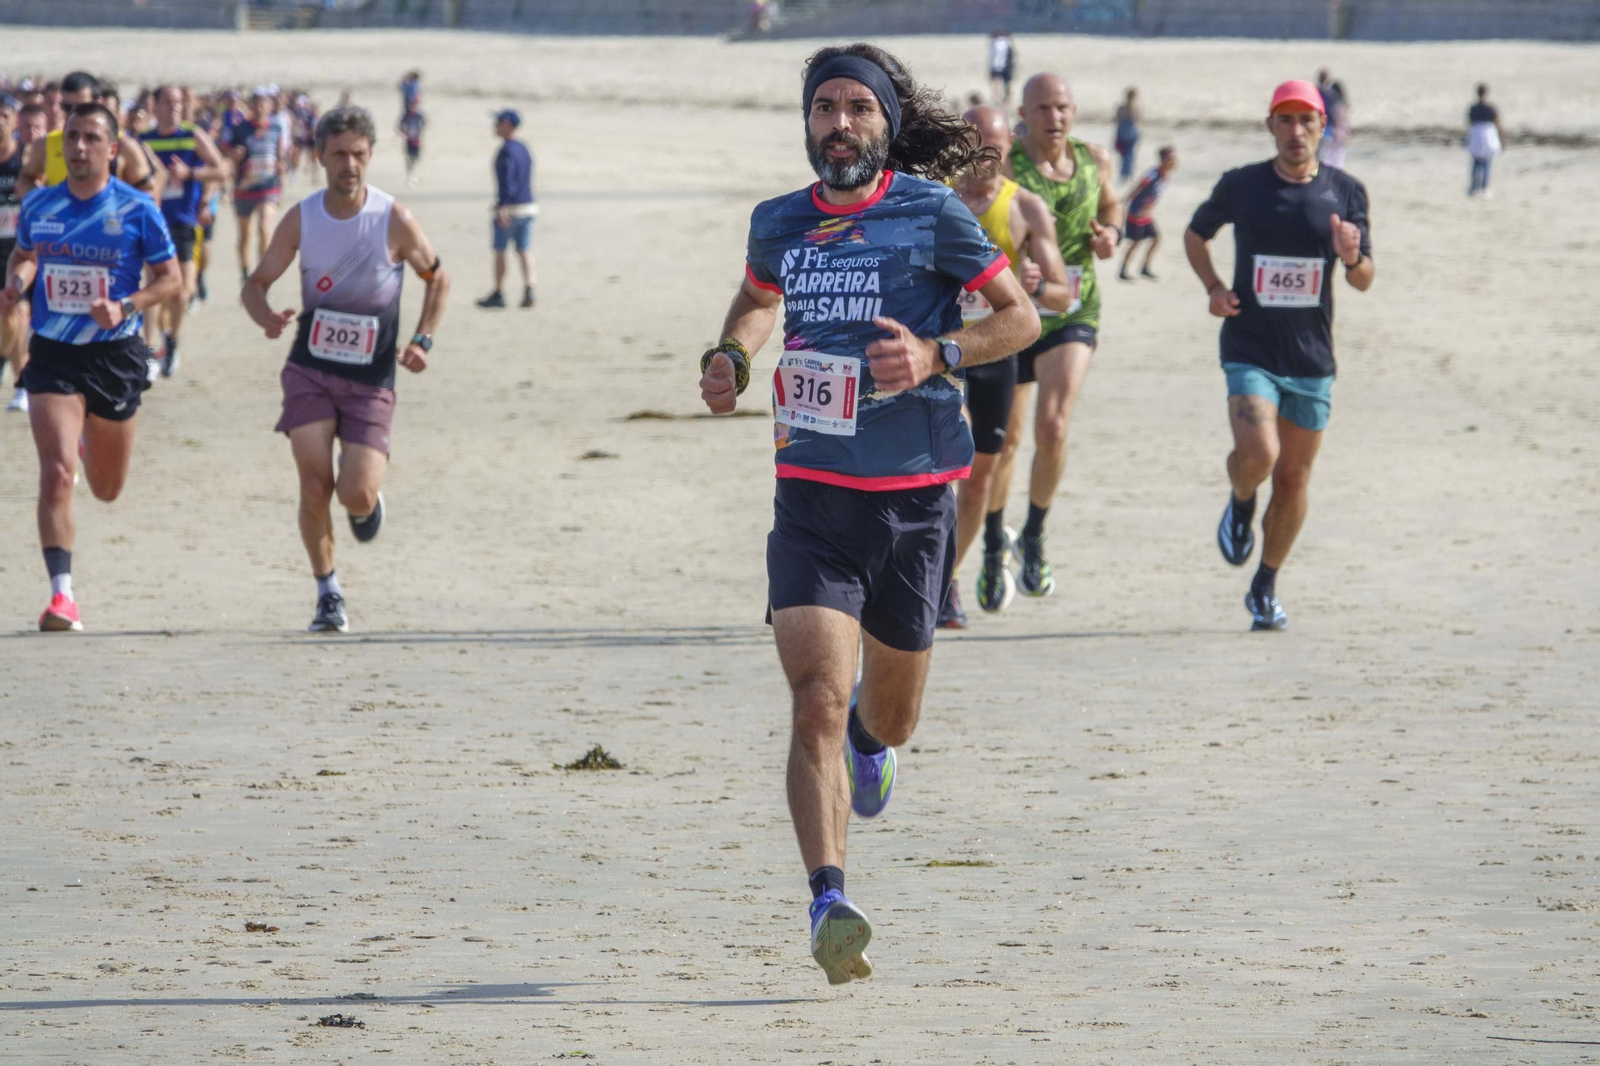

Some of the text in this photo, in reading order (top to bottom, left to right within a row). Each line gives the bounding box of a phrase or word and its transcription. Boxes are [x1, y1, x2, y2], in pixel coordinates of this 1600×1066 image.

[830, 256, 880, 271] seguros
[58, 280, 92, 296] 523
[785, 271, 880, 296] CARREIRA
[1270, 273, 1305, 288] 465
[786, 298, 815, 312] PRAIA
[802, 311, 816, 322] DE
[325, 327, 360, 346] 202
[793, 374, 832, 406] 316
